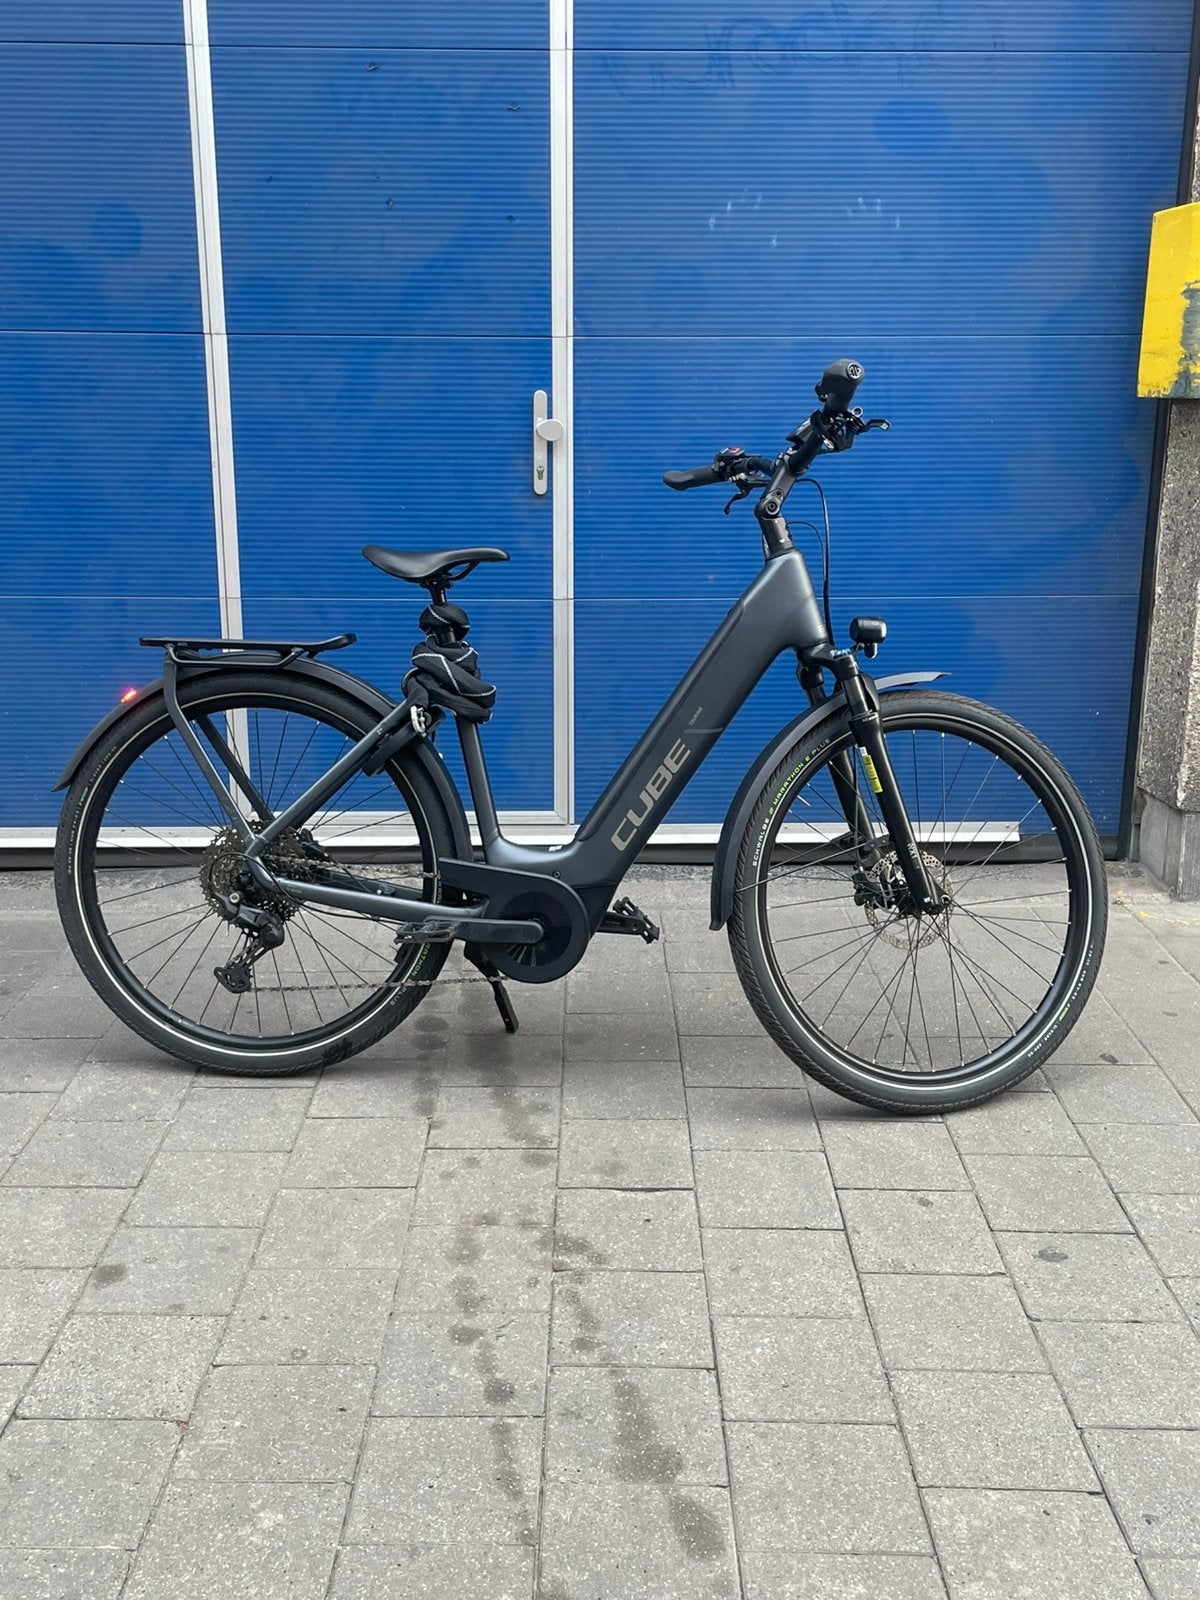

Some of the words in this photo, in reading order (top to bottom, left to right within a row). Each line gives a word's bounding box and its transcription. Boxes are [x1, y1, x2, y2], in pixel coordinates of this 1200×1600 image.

[611, 738, 691, 851] CUBE
[752, 818, 770, 867] SCHWALBE
[773, 762, 804, 806] MARATHON
[811, 739, 830, 755] PLUS
